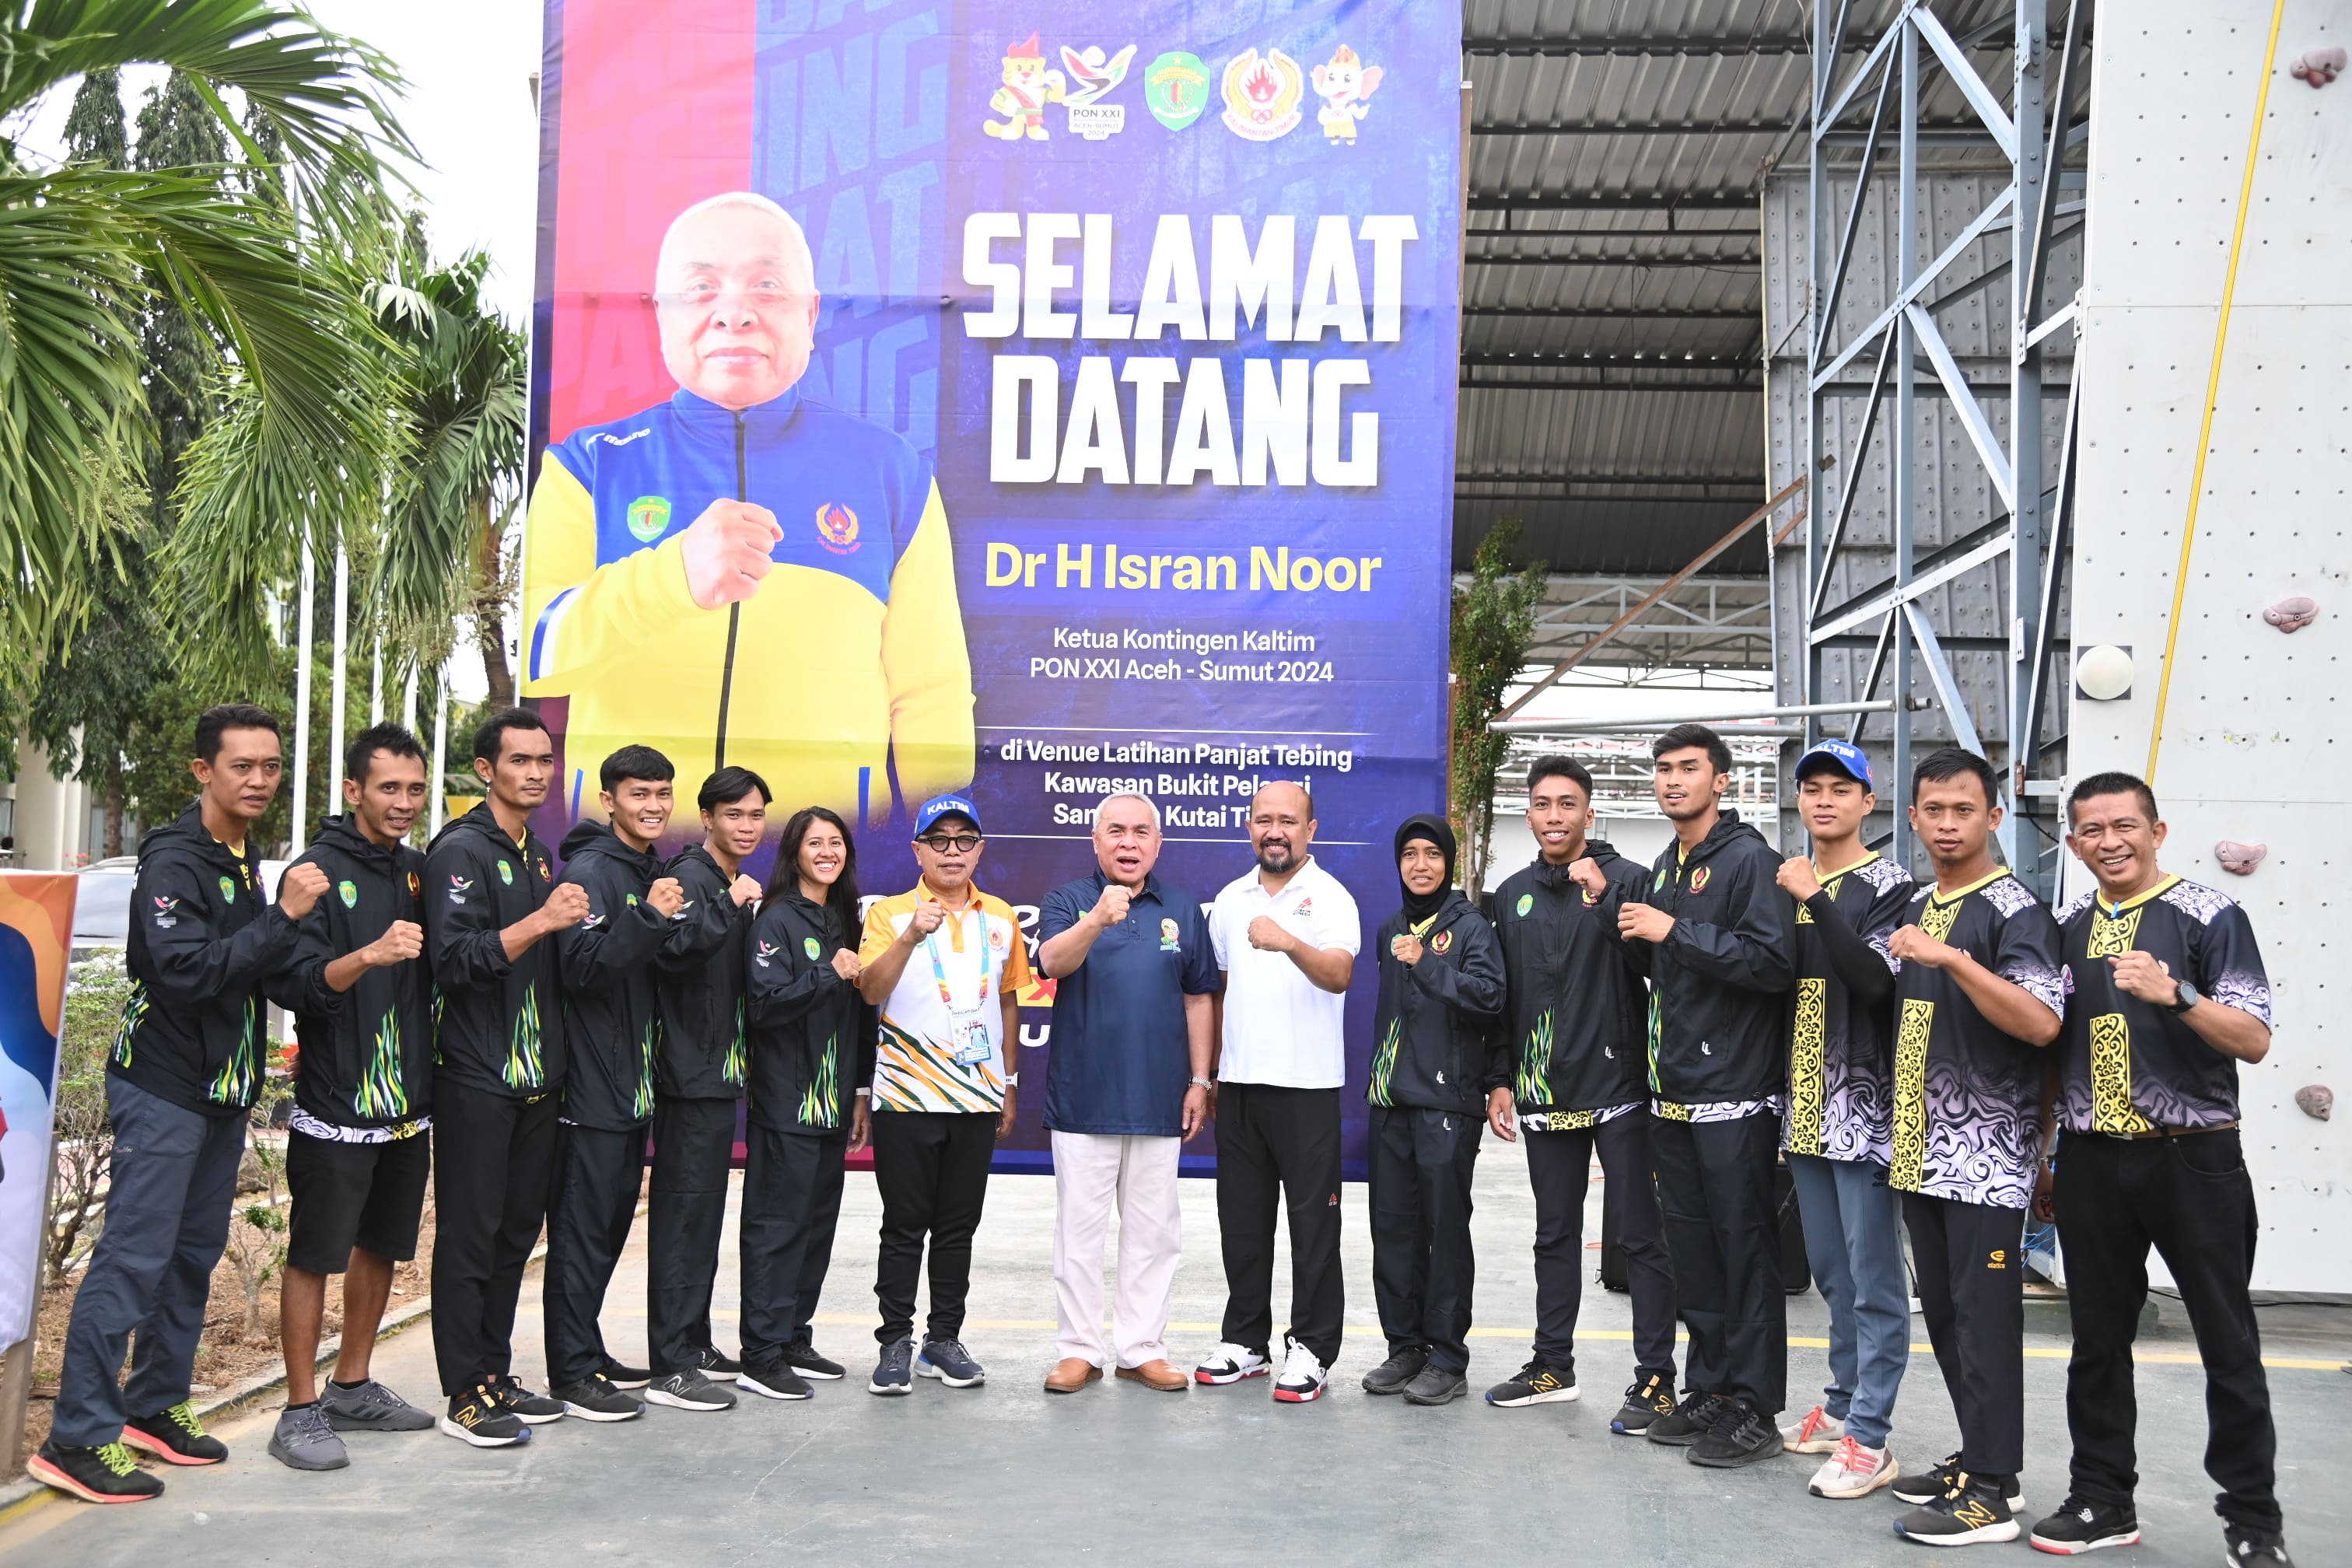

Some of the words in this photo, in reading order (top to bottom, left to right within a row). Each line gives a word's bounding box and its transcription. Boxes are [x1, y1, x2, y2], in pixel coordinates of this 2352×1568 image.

[1073, 109, 1098, 118] PON
[1101, 109, 1120, 118] XXI
[962, 212, 1419, 342] SELAMAT
[990, 355, 1379, 486] DATANG
[987, 543, 1047, 587] Dr
[1058, 544, 1093, 587] H
[1105, 544, 1237, 590] Isran
[1251, 547, 1382, 591] Noor
[1053, 628, 1118, 650] Ketua
[1123, 628, 1238, 656] Kontingen
[1243, 629, 1315, 652] Kaltim
[1031, 657, 1080, 678] PON
[1083, 658, 1120, 679] XXI
[1124, 658, 1181, 680] Aceh
[1199, 660, 1274, 681] Sumut
[1277, 661, 1334, 683] 2024
[1000, 739, 1023, 761] di
[1025, 740, 1100, 762] Venue
[1104, 740, 1190, 765] Latihan
[1195, 742, 1270, 770] Panjat
[1273, 744, 1353, 772] Tebing
[1808, 744, 1855, 759] ALTIM
[1044, 772, 1153, 794] Kawasan
[1157, 773, 1219, 796] Bukit
[926, 800, 970, 816] KALTIM
[1165, 803, 1227, 828] Kutai
